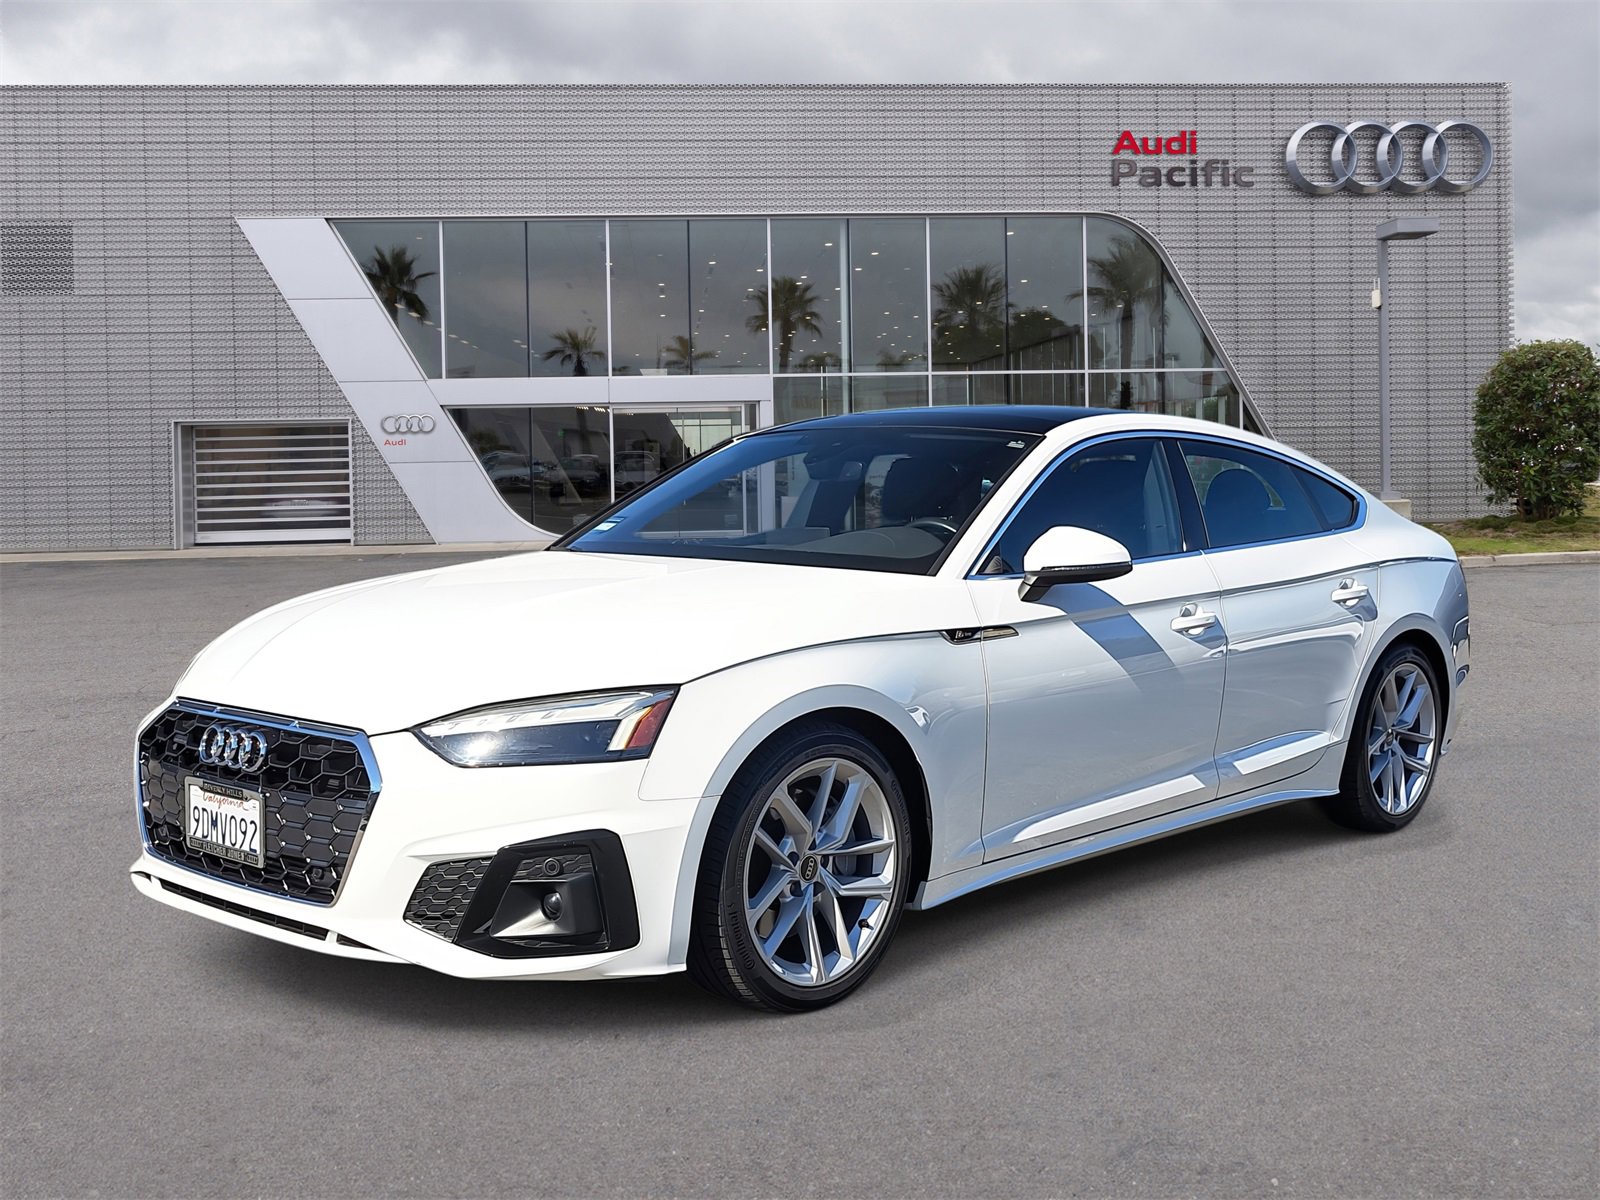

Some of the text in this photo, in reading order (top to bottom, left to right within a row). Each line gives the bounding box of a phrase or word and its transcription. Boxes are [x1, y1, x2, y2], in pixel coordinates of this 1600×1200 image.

[1111, 130, 1198, 155] Audi
[1111, 158, 1255, 187] Pacific
[226, 787, 243, 798] HILLS
[193, 806, 258, 853] 9DMV092
[227, 848, 245, 861] JONES
